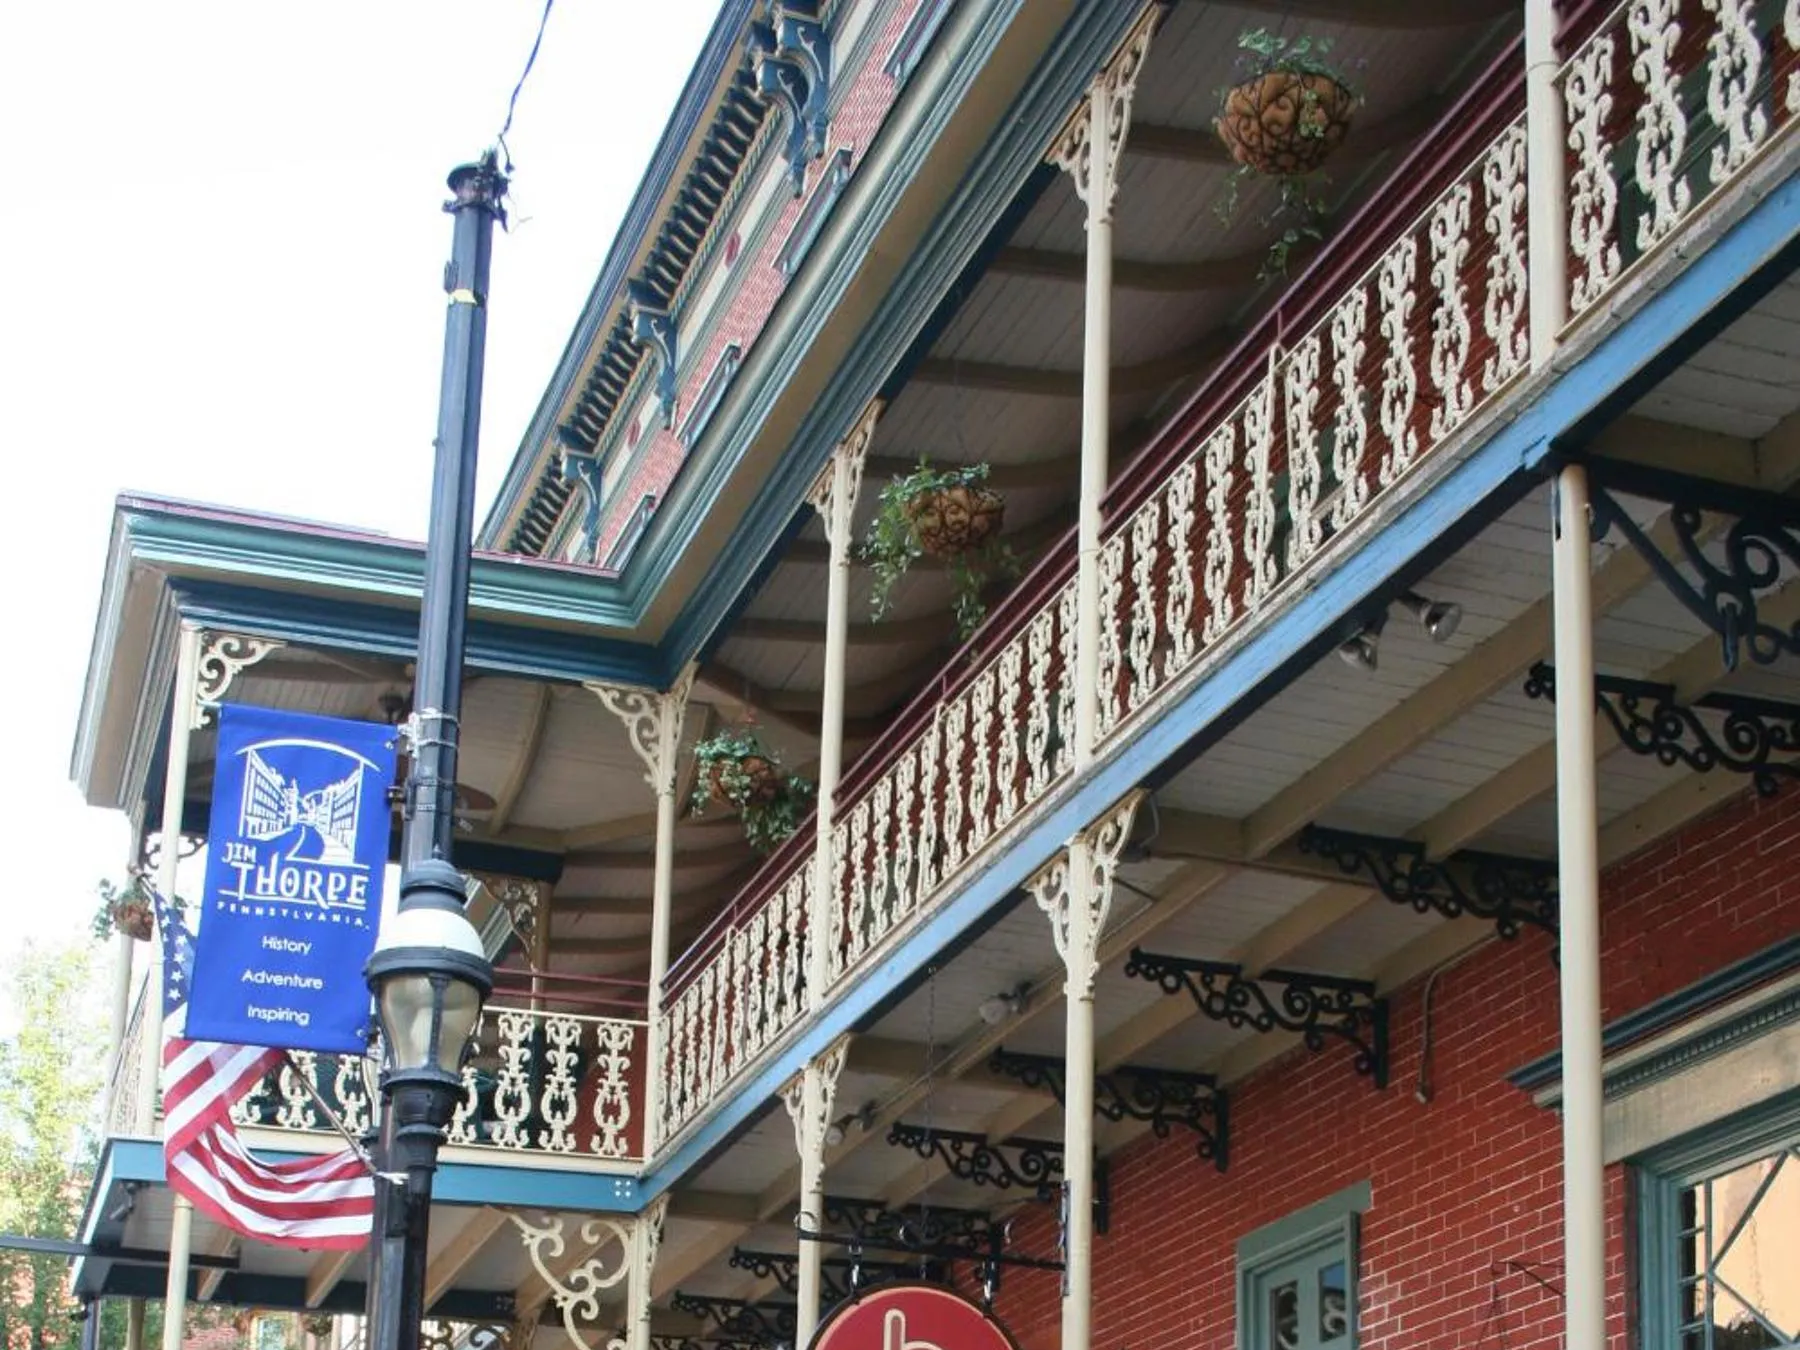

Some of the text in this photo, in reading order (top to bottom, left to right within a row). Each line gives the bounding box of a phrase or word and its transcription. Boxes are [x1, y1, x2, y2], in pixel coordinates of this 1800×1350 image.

[221, 842, 257, 863] JIM
[230, 852, 369, 910] THORPE
[217, 901, 363, 927] PENNSYLVANIA
[262, 935, 312, 956] History
[241, 969, 323, 990] Adventure
[247, 1004, 310, 1026] Inspiring
